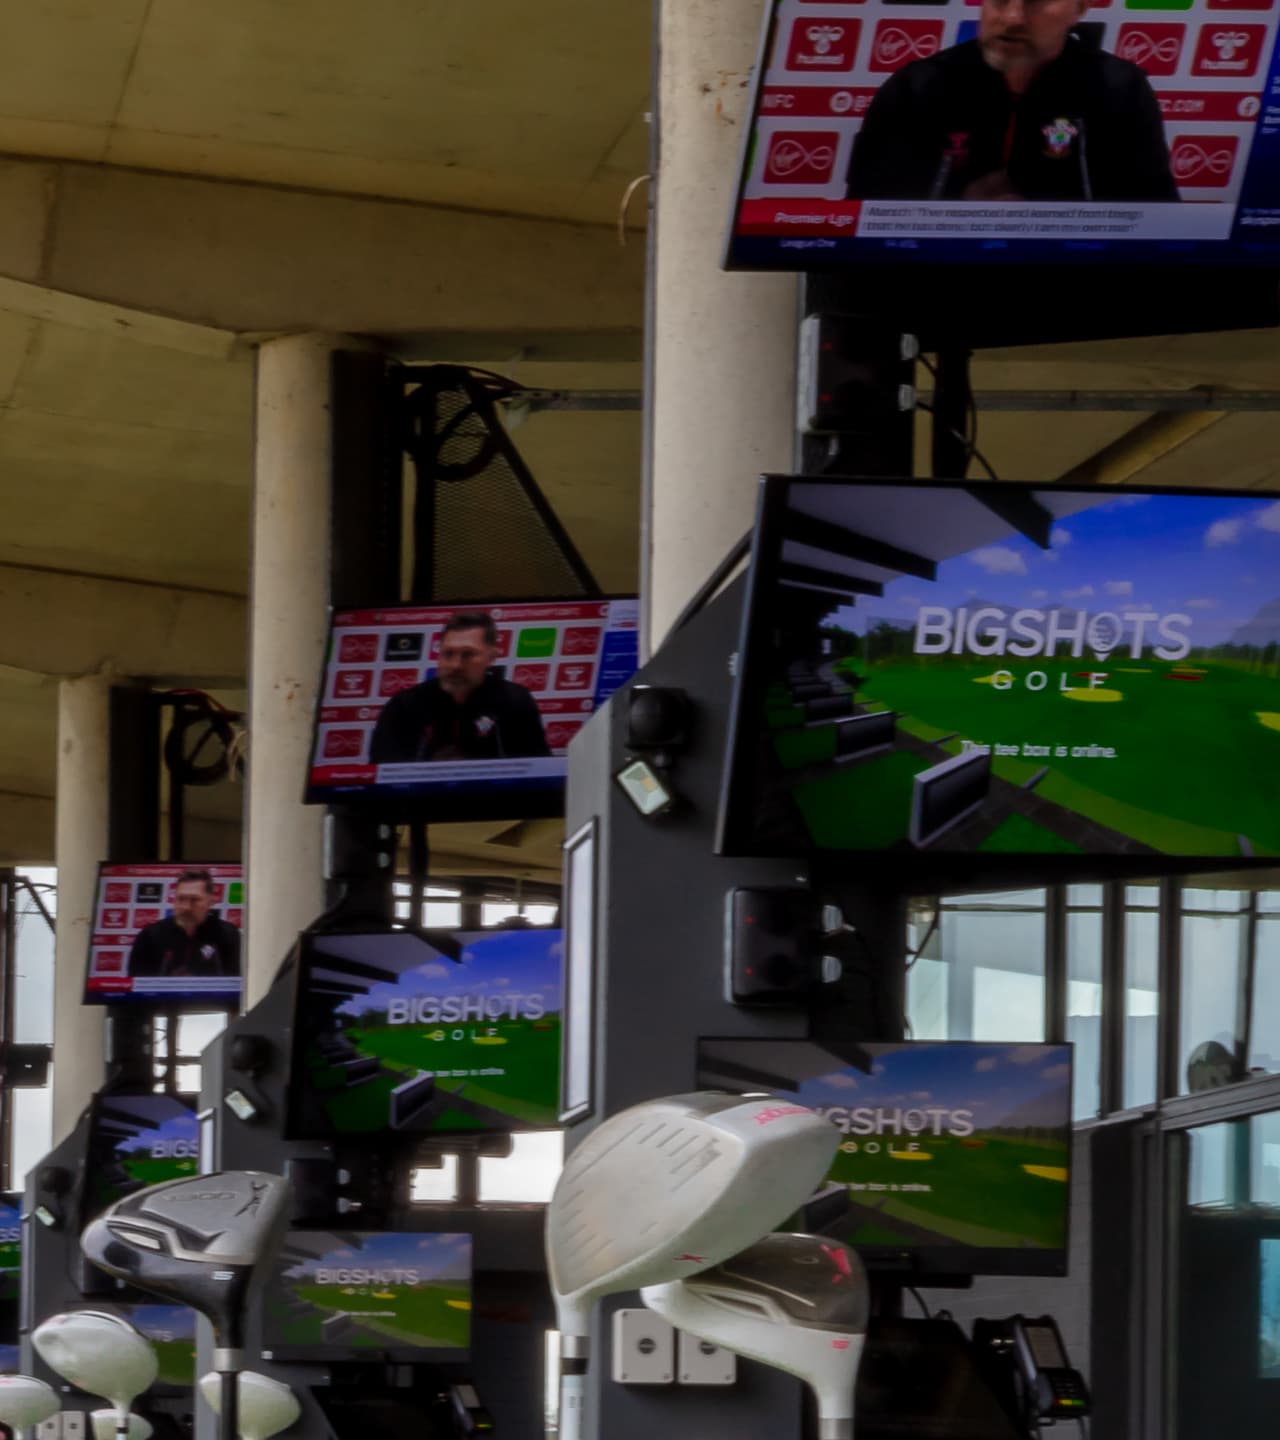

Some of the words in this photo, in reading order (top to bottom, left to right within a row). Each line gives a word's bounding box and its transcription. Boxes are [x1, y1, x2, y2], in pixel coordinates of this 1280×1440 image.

[774, 211, 825, 225] Premier
[828, 213, 854, 227] Lge
[913, 606, 1193, 661] BIGSHOTS
[991, 670, 1109, 692] GOLF
[993, 742, 1019, 757] tee
[1023, 741, 1052, 757] box
[1055, 742, 1068, 757] is
[387, 993, 545, 1025] BIGSHOTS
[314, 1268, 420, 1286] BIGSHOTS
